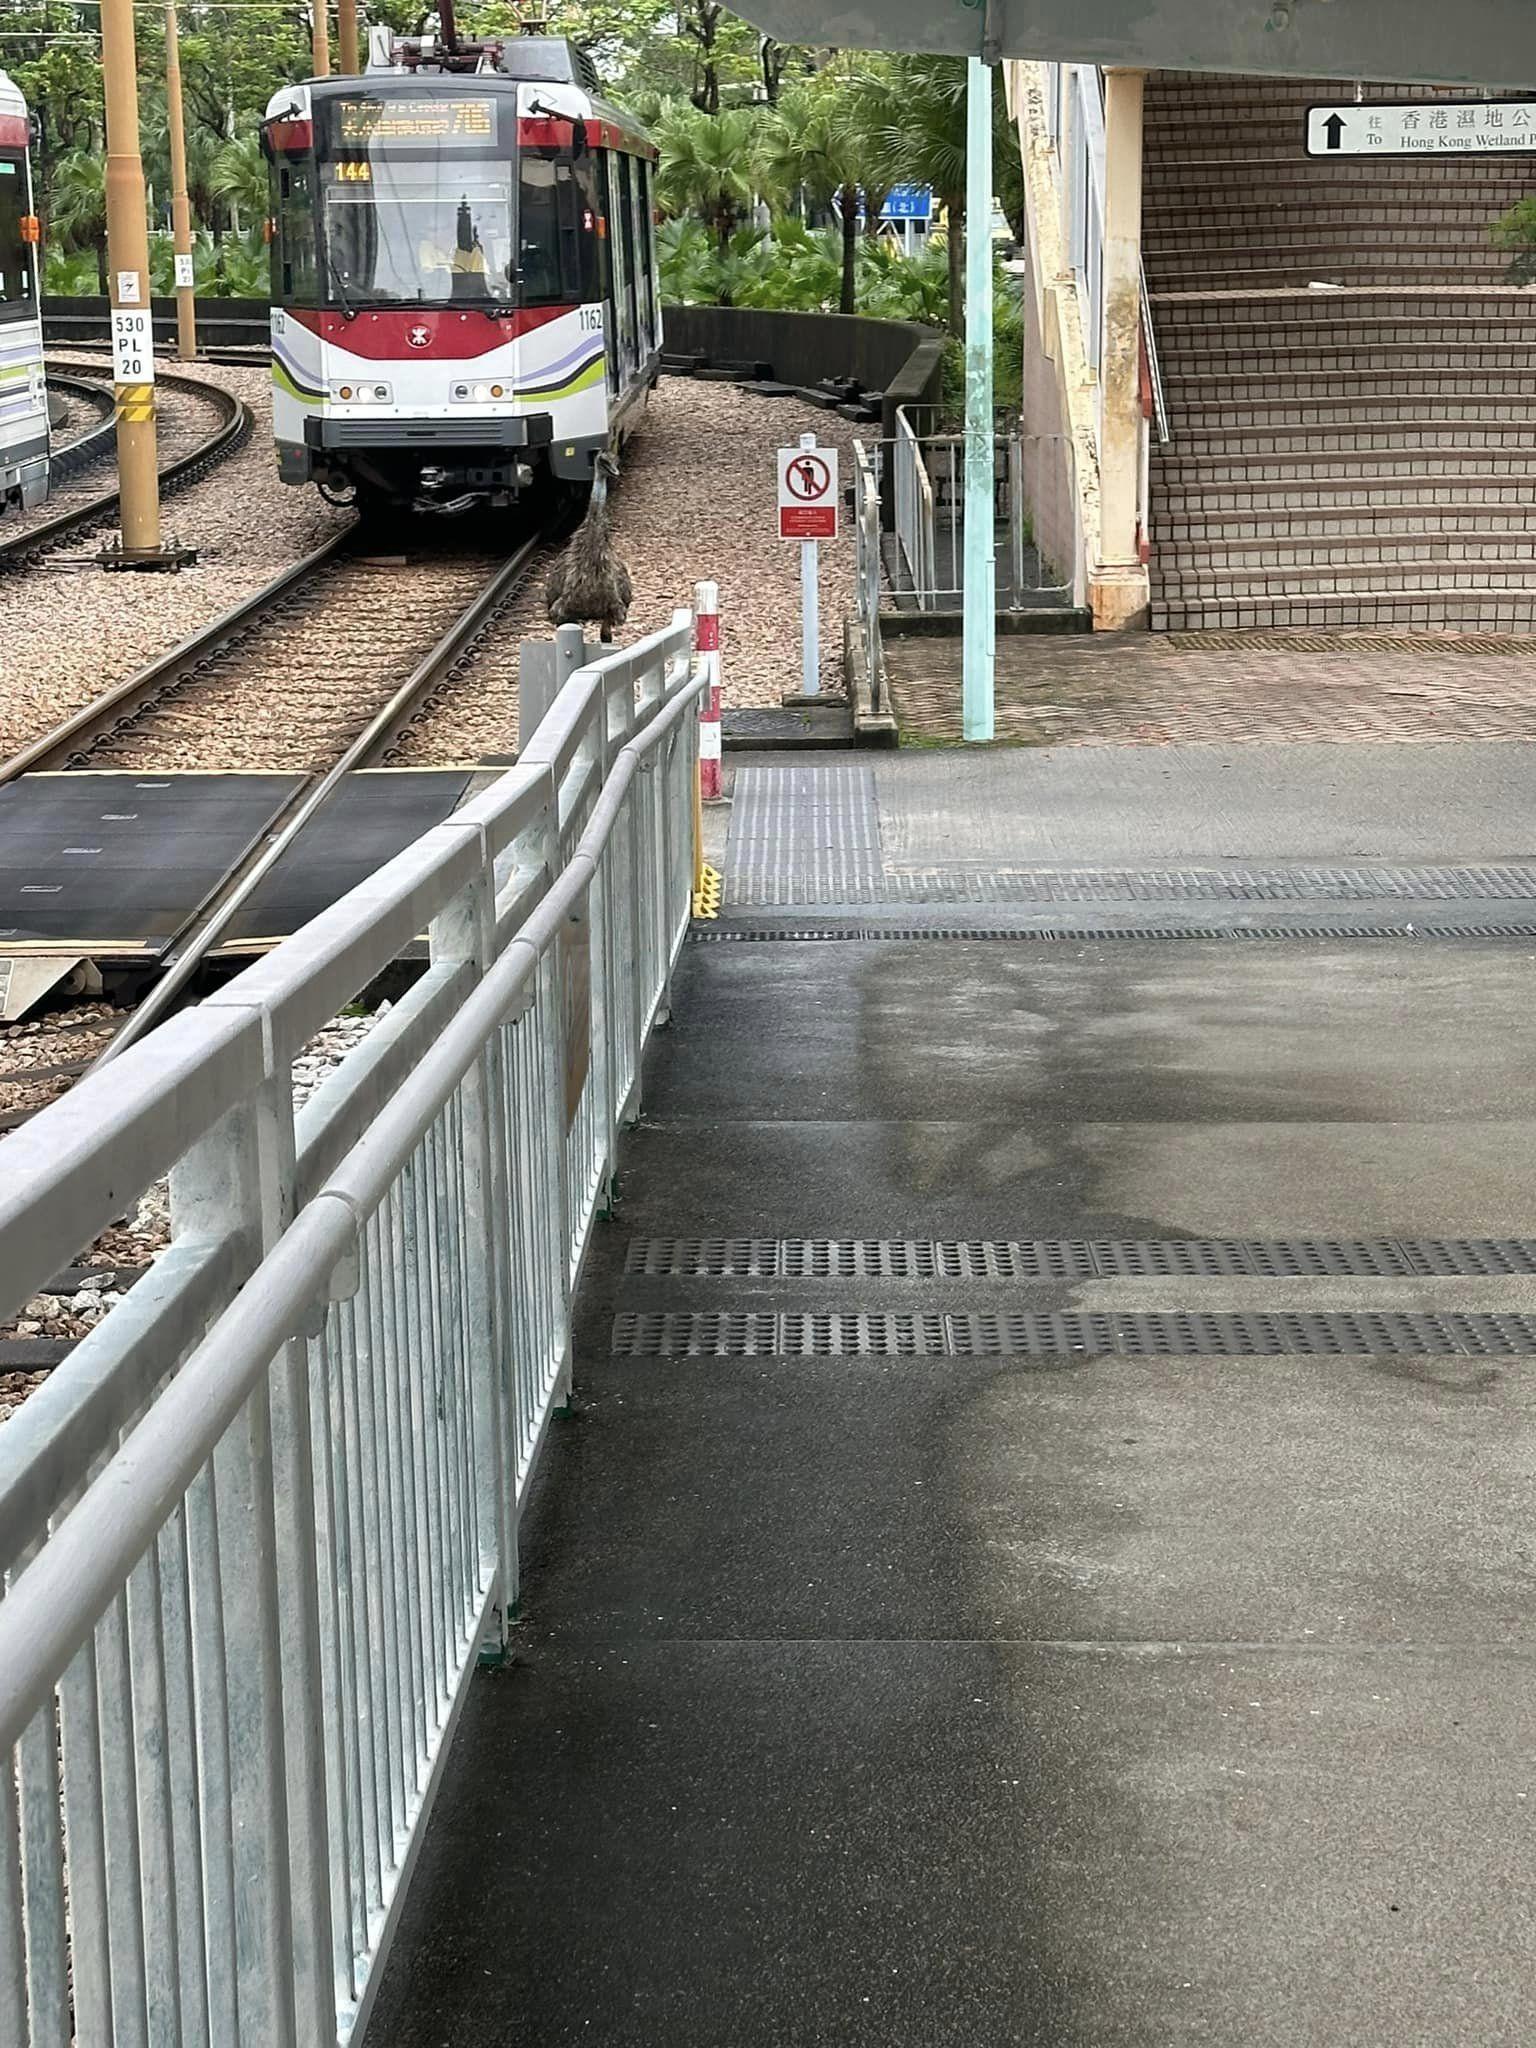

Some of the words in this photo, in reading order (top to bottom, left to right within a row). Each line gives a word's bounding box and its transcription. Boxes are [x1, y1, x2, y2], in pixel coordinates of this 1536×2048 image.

[1368, 114, 1382, 129] 往
[1366, 133, 1383, 145] To
[1400, 136, 1434, 151] Hong
[1438, 135, 1472, 150] Kong
[1475, 132, 1526, 147] Wetland
[335, 162, 370, 182] 144
[115, 316, 145, 333] 530
[579, 309, 603, 331] 1162
[118, 338, 143, 353] PL
[122, 359, 142, 375] 20
